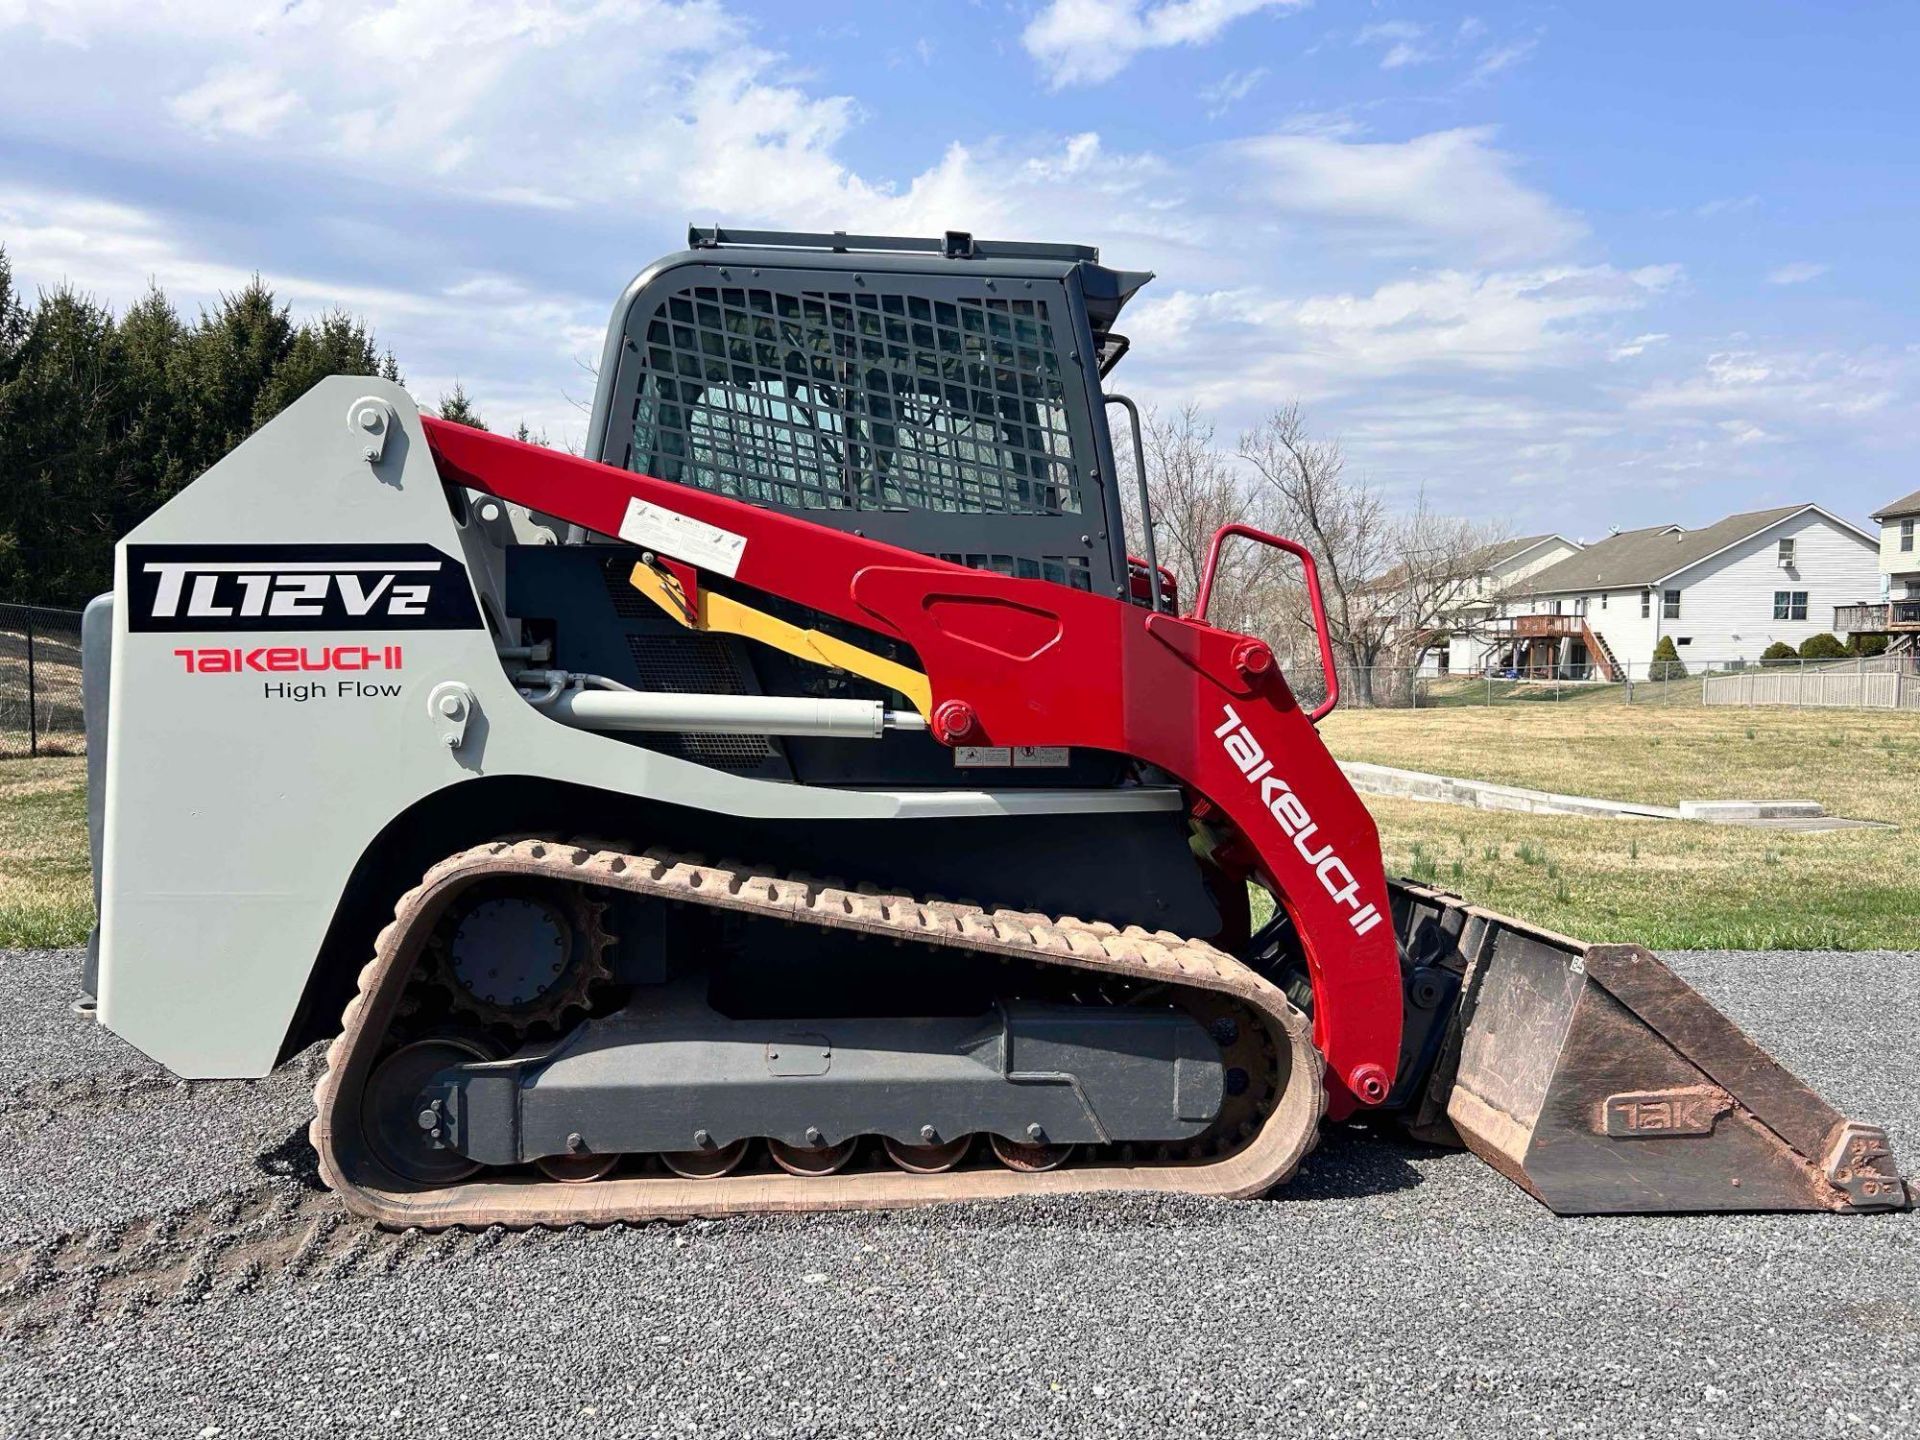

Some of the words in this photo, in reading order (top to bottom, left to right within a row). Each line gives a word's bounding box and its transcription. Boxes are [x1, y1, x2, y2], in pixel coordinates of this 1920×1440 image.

[143, 561, 441, 617] TL12V2
[174, 646, 402, 674] TAKEUCHI
[264, 681, 326, 702] High
[339, 681, 402, 698] Flow
[1214, 704, 1383, 936] TAKEUCHI
